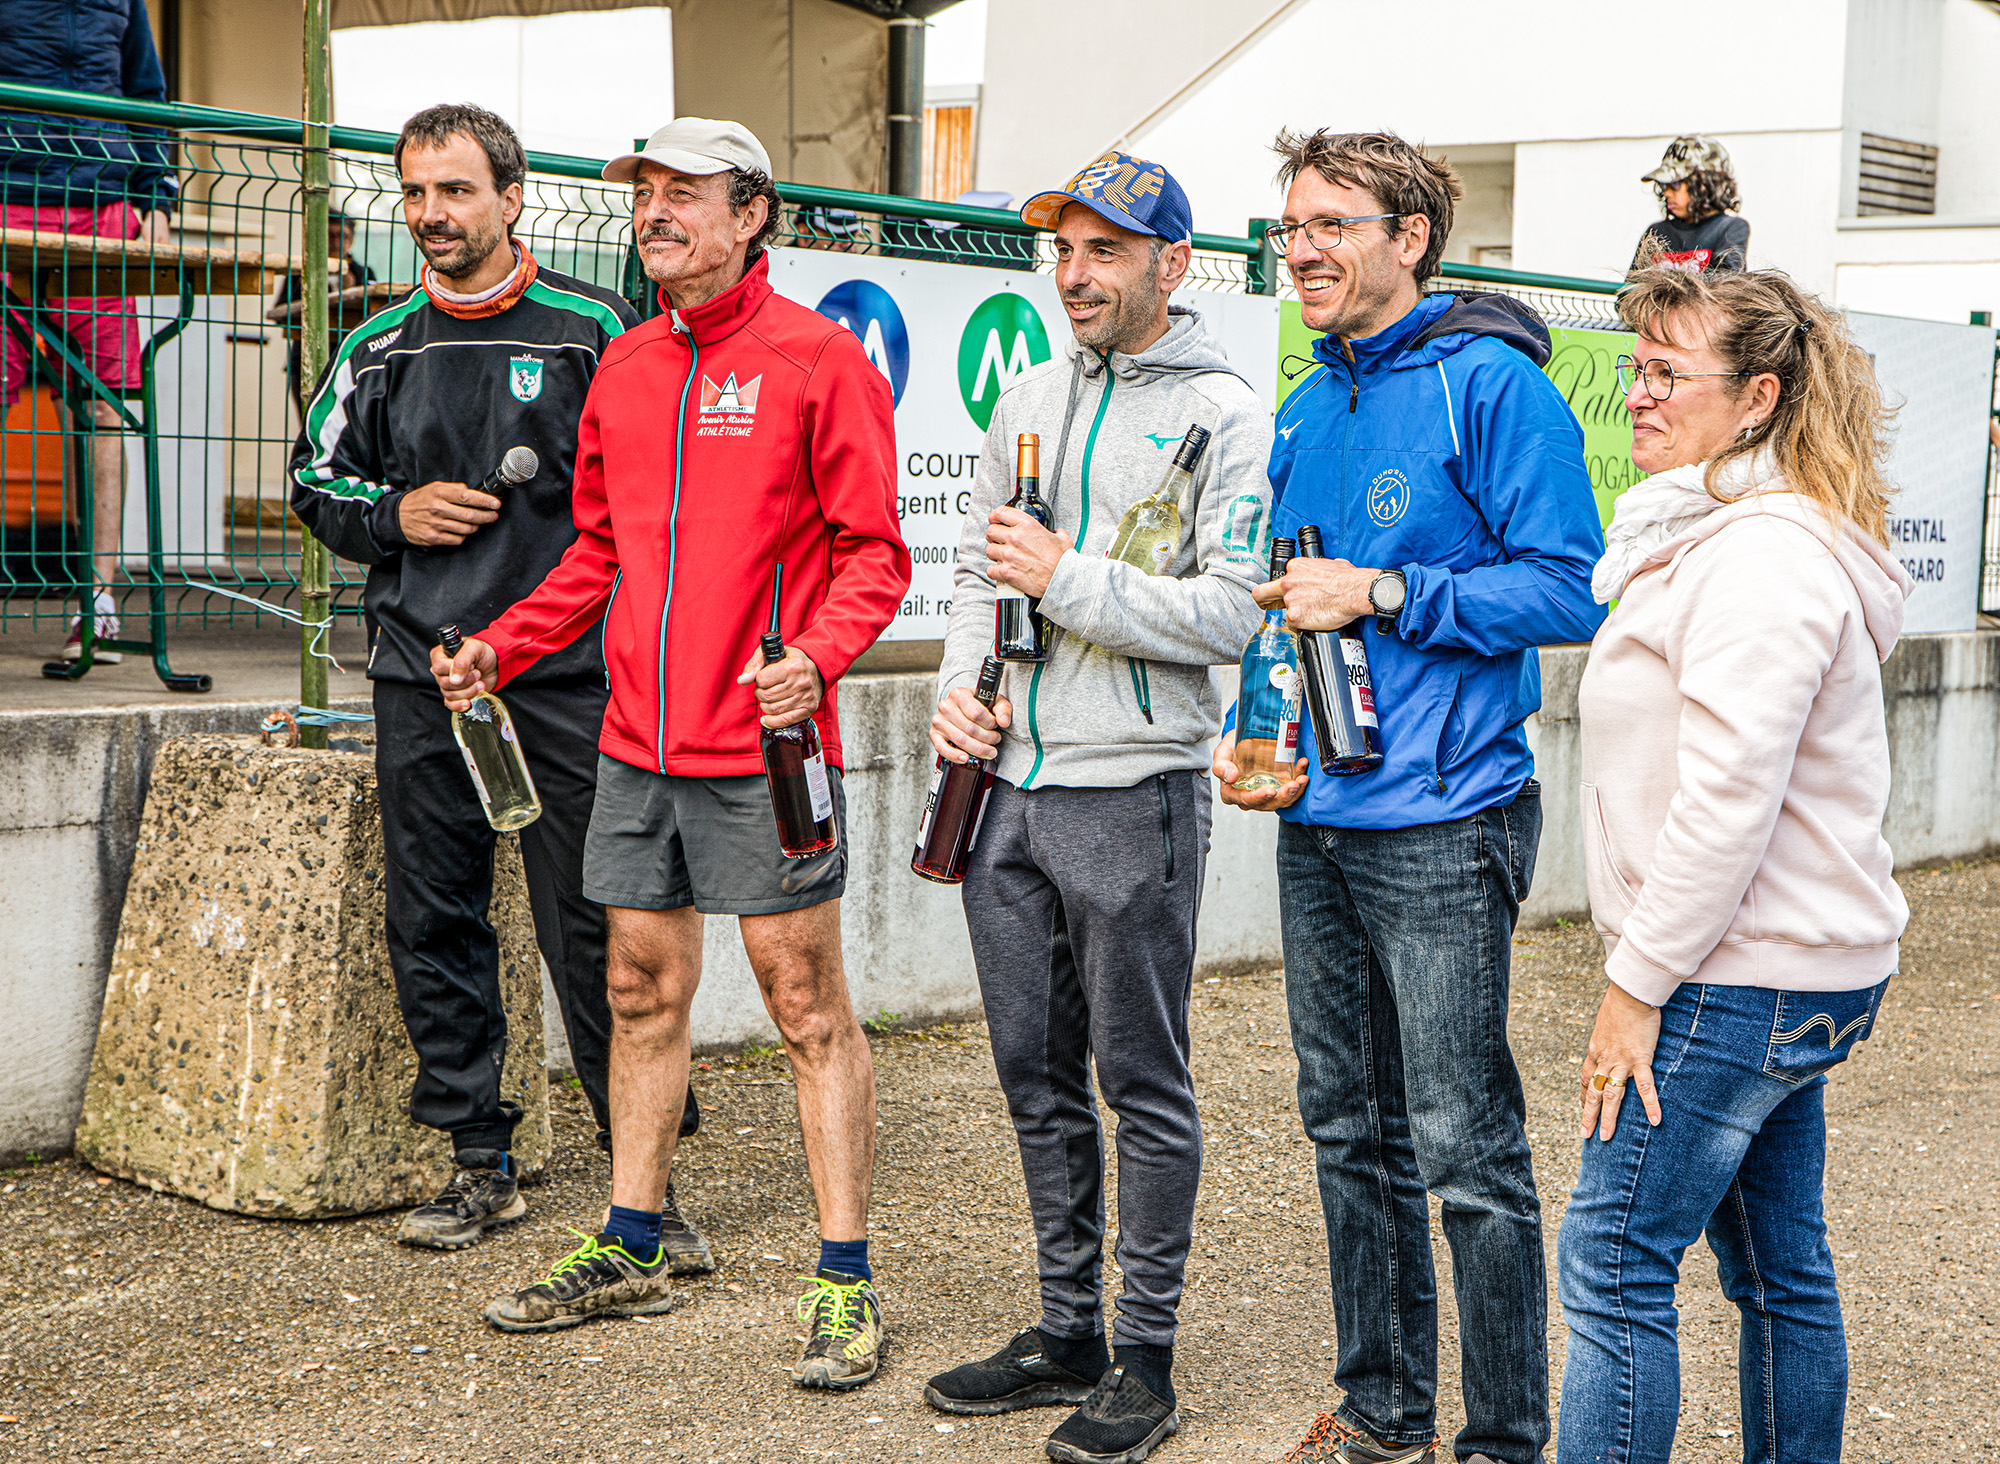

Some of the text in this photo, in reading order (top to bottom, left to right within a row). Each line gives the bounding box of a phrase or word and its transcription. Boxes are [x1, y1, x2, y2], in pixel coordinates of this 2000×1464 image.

[697, 414, 725, 425] Avenir
[696, 424, 754, 437] ATHLÉTISME
[1887, 519, 1946, 542] MENTAL
[909, 546, 947, 564] 0000
[898, 595, 929, 616] ail:
